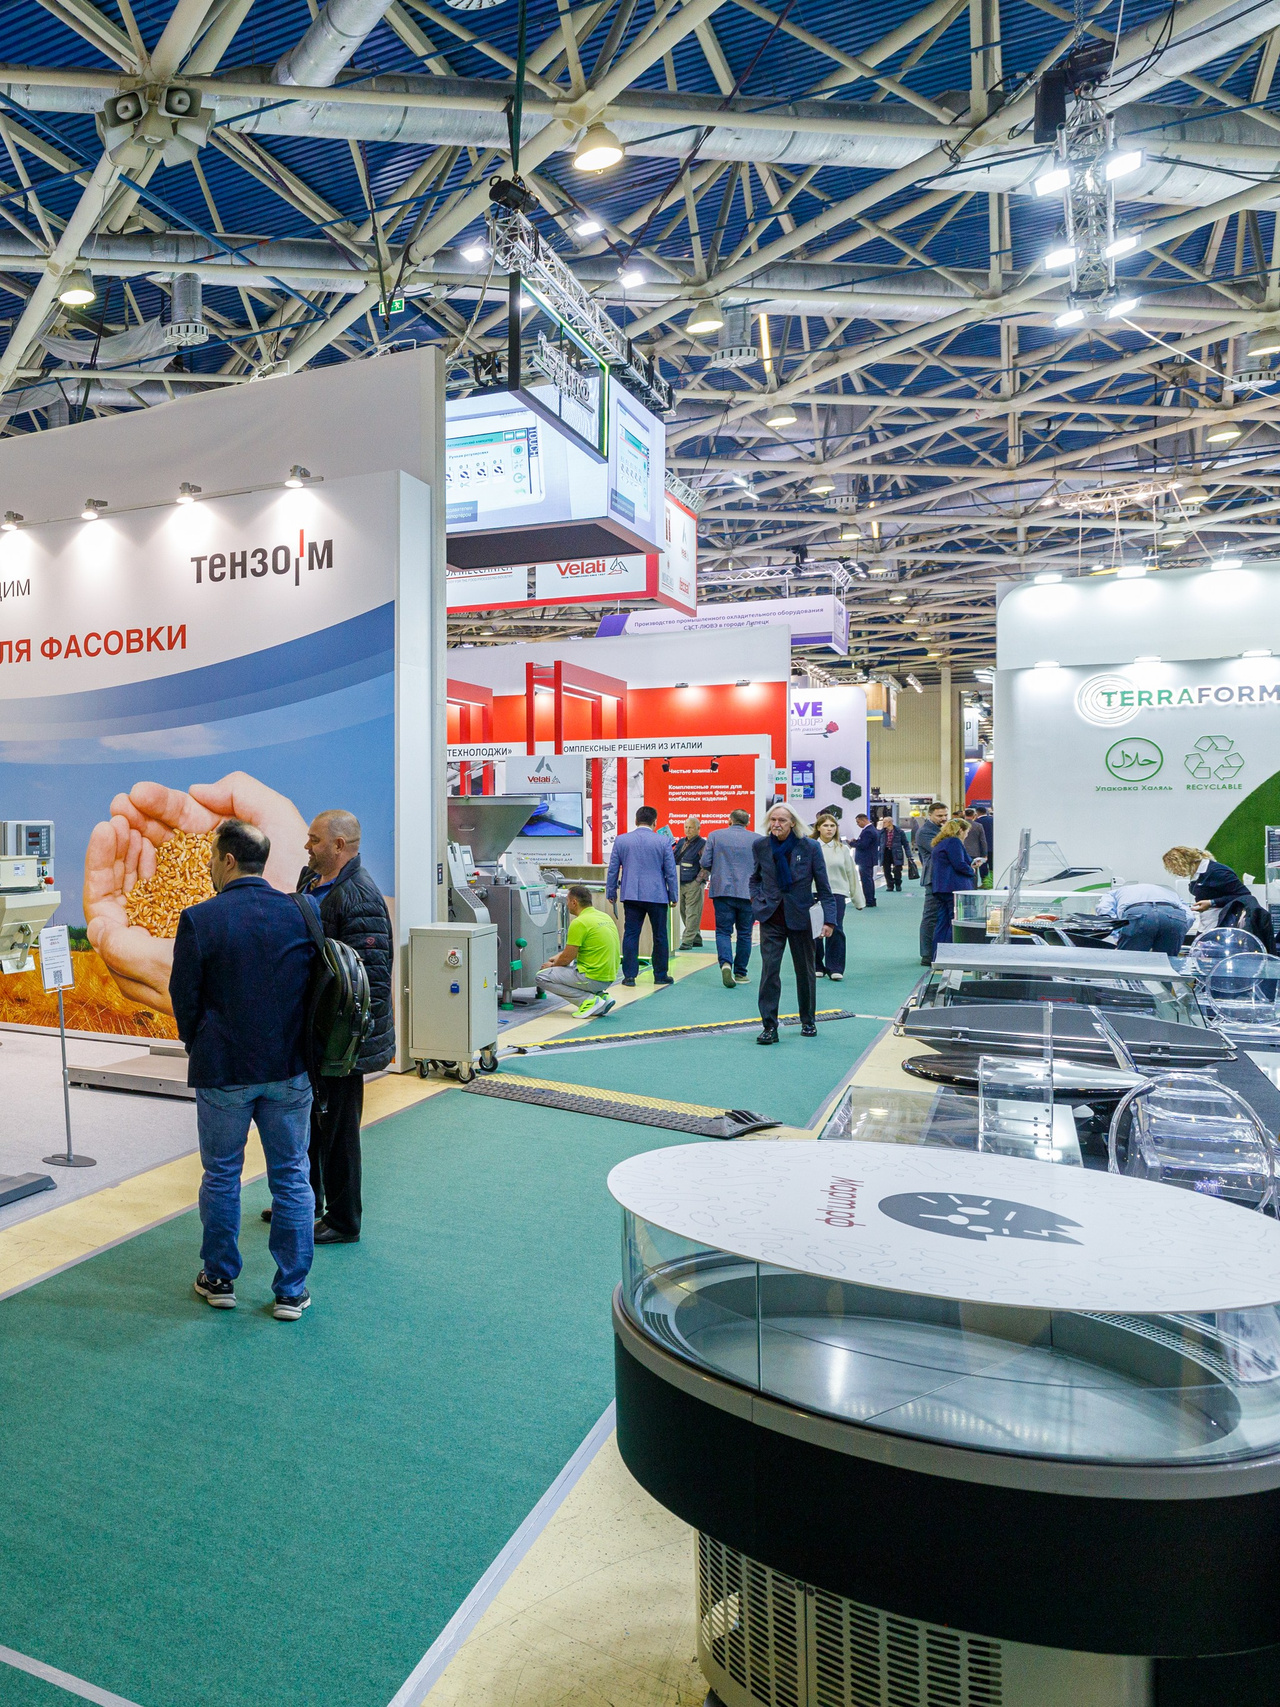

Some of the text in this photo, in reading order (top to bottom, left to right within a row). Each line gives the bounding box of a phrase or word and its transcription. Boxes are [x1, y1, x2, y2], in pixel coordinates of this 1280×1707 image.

[556, 560, 606, 576] Velati
[40, 624, 187, 660] ФАСОВКИ
[563, 741, 703, 753] ОМПЛЕКСНЫЕ РЕШЕНИЯ ИЗ ИТАЛИИ
[1186, 783, 1243, 791] RECYCLABLE
